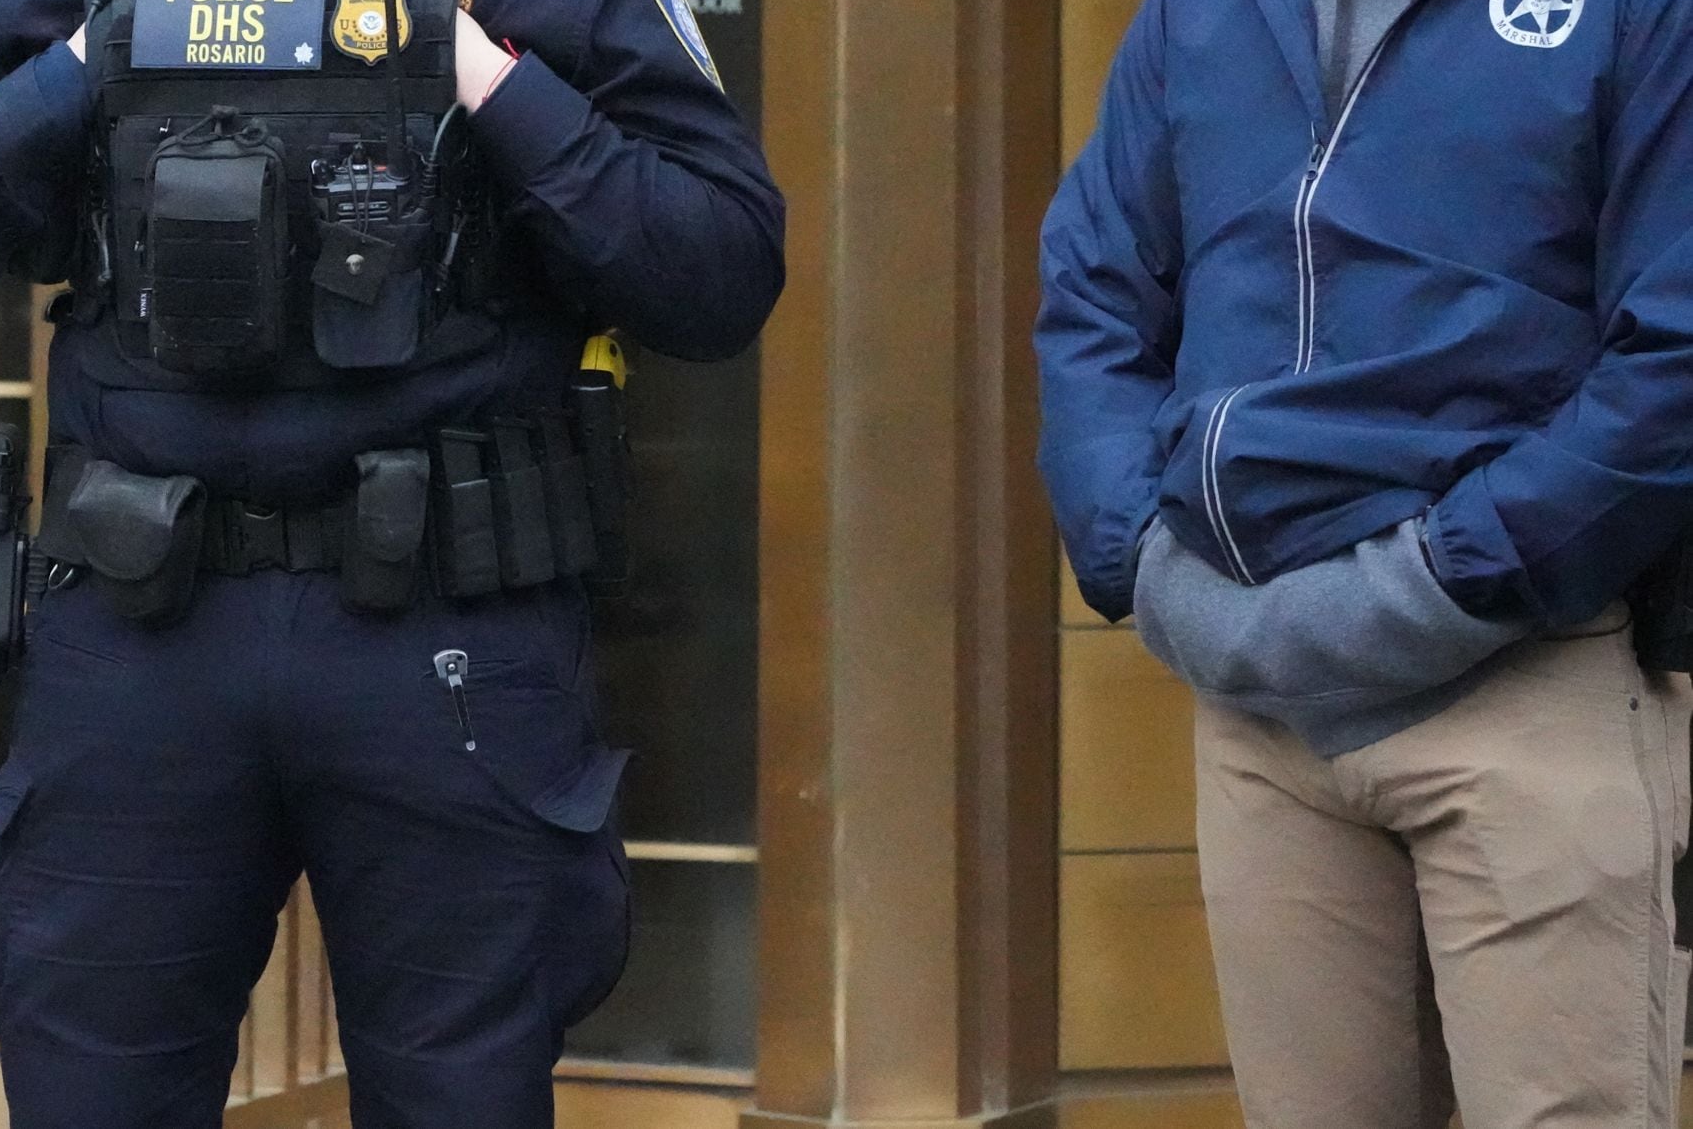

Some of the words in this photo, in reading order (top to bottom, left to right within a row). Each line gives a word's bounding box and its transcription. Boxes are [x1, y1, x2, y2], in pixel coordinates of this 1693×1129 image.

[189, 4, 265, 42] DHS
[1496, 20, 1554, 46] MARSHAL
[186, 44, 266, 64] ROSARIO
